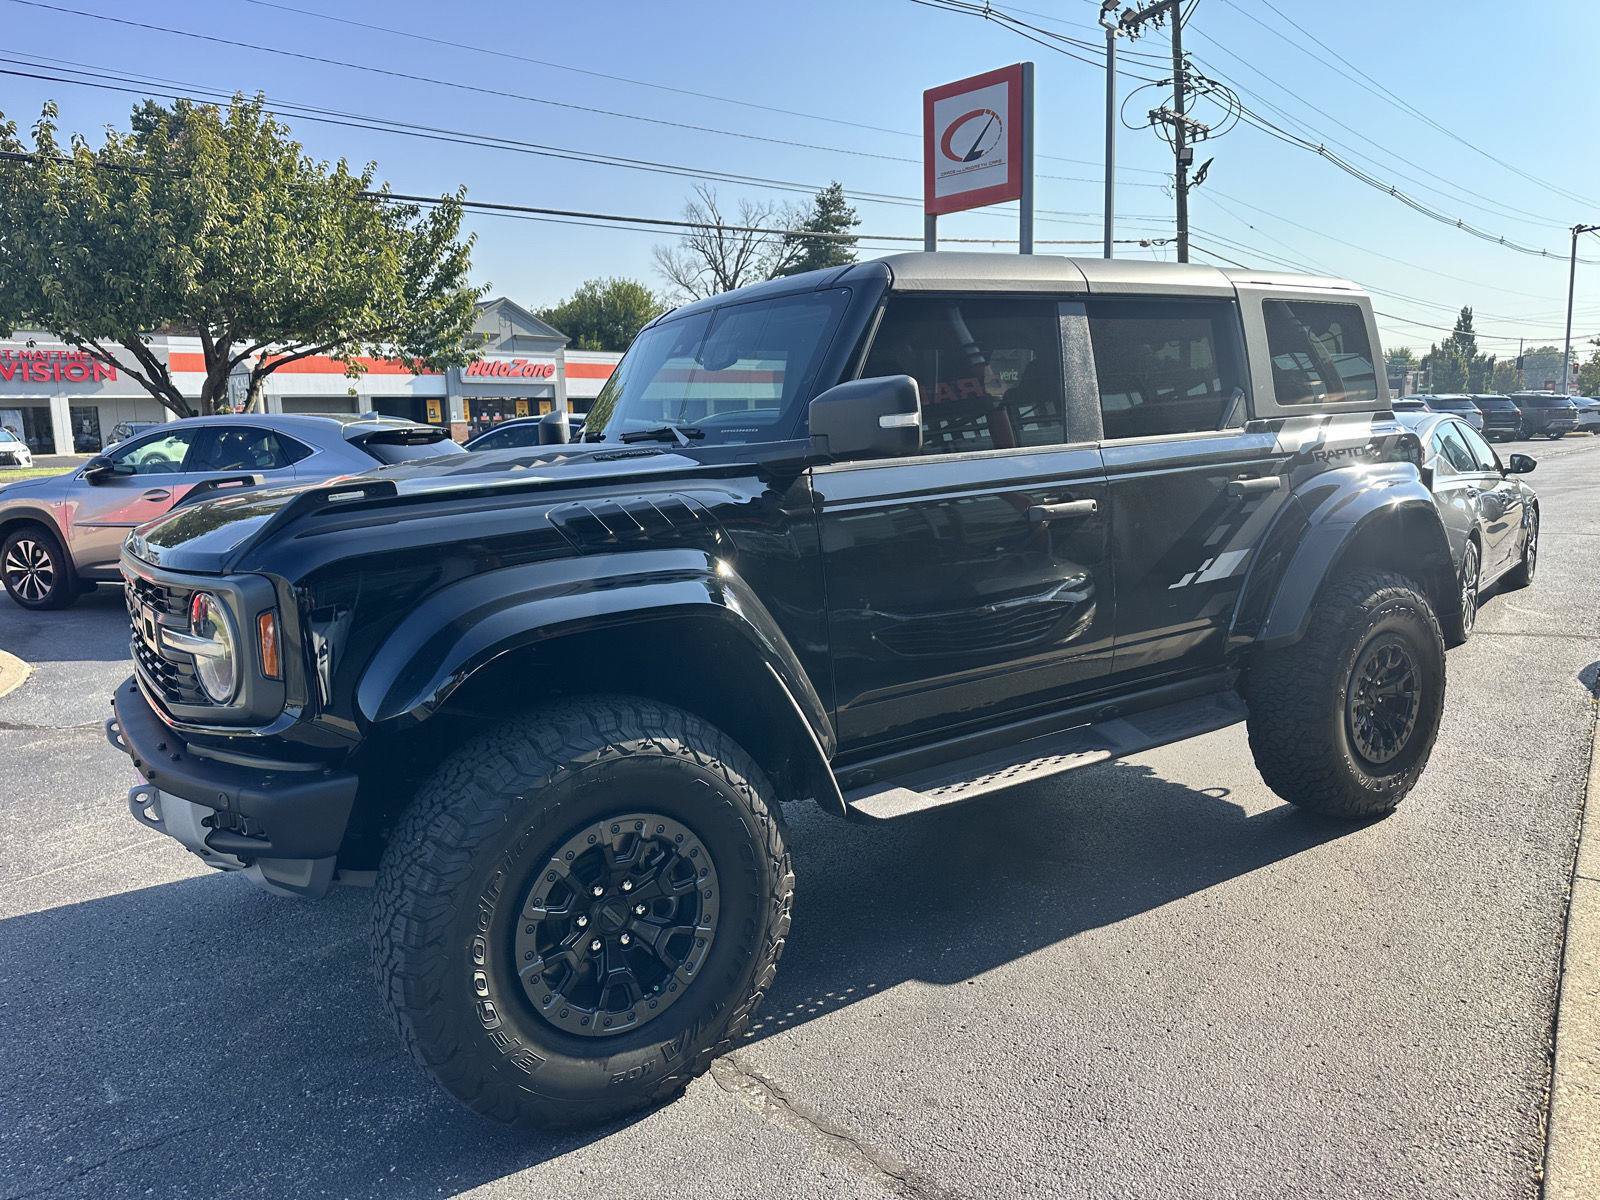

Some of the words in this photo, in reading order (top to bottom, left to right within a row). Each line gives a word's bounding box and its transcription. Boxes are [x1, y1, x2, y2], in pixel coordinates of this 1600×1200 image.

[0, 350, 13, 361] T
[18, 350, 114, 362] MATTHE
[0, 361, 117, 383] VISION
[465, 359, 555, 379] AutoZone
